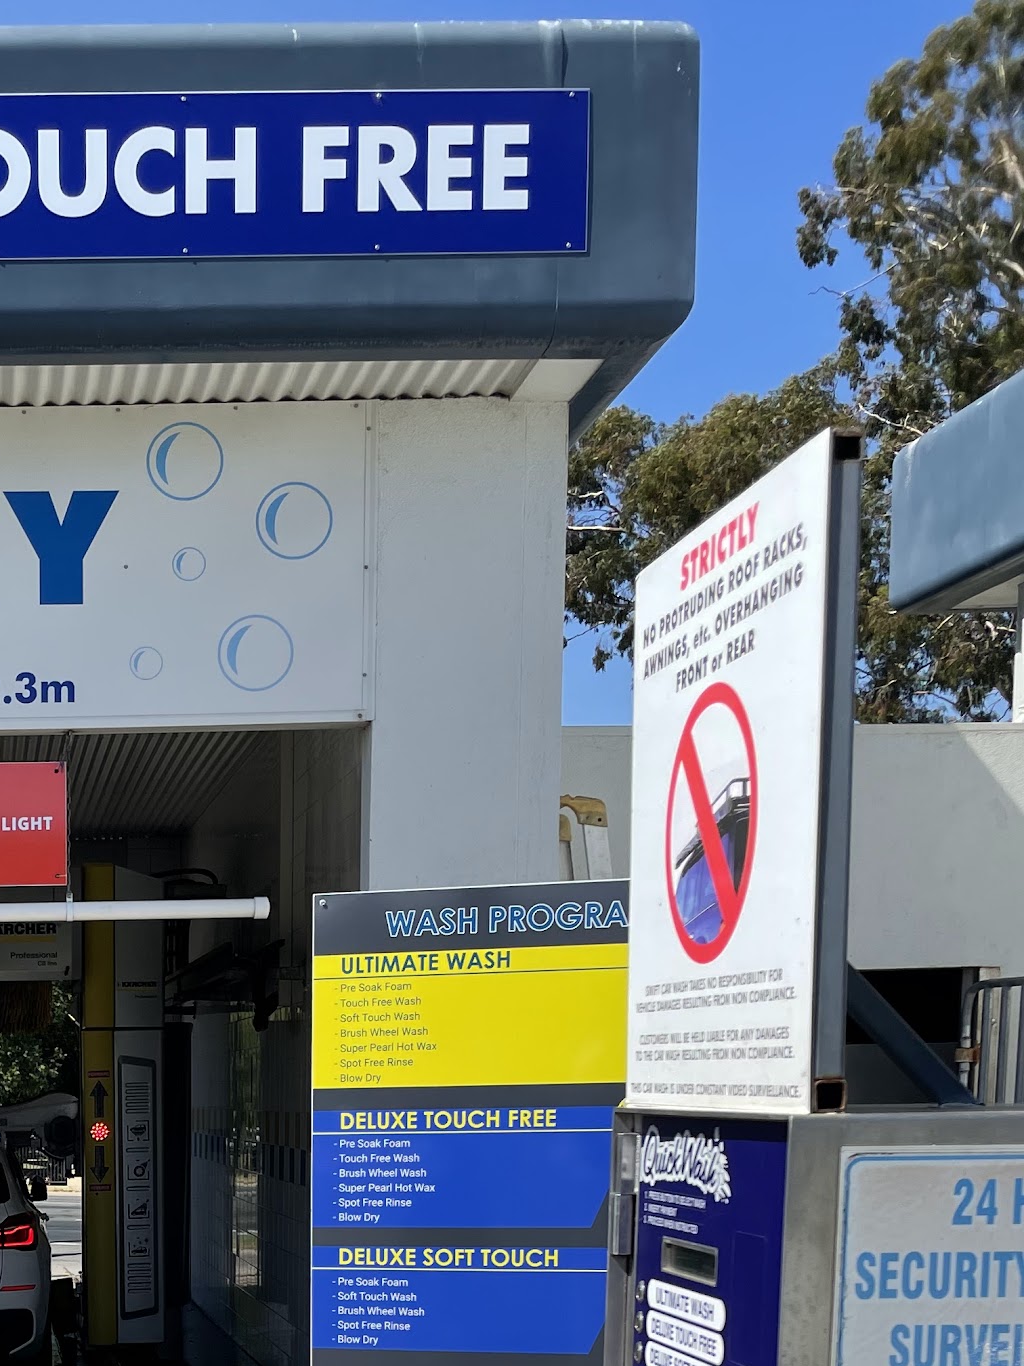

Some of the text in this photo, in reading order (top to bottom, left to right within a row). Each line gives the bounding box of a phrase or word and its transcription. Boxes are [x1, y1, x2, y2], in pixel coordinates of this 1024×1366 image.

[302, 123, 531, 213] FREE
[680, 501, 760, 591] STRICTLY
[643, 521, 808, 650] NO PROTRUDING ROOF RACKS,
[643, 561, 803, 680] AWNINGS, etc. OVERHANGING
[676, 629, 756, 693] FRONT or REAR
[0, 815, 54, 832] LIGHT
[385, 907, 478, 938] WASH
[10, 951, 58, 960] Professional
[341, 951, 511, 975] ULTIMATE WASH
[340, 981, 412, 993] Pre Soak Foam
[340, 996, 422, 1008] Touch Free Wash
[340, 1011, 421, 1023] Soft Touch Wash
[340, 1026, 429, 1038] Brush Wheel Wash
[756, 1026, 790, 1040] DAMAGES
[340, 1041, 437, 1055] Super Pearl Hot Wax
[340, 1057, 414, 1070] Spot Free Rinse
[340, 1073, 382, 1085] Blow Dry
[340, 1109, 557, 1130] DELUXE TOUCH FREE
[339, 1138, 411, 1148] Pre Soak Foam
[339, 1153, 420, 1163] Touch Free Wash
[339, 1168, 427, 1178] Brush Wheel Wash
[338, 1182, 436, 1195] Super Pearl Hot Wax
[338, 1197, 412, 1209] Spot Free Rinse
[952, 1178, 999, 1225] 24
[338, 1212, 380, 1224] Blow Dry
[339, 1247, 559, 1267] DELUXE SOFT TOUCH
[337, 1277, 409, 1287] Pre Soak Foam
[337, 1291, 417, 1302] Soft Touch Wash
[656, 1286, 715, 1322] ULTIMATE WASH
[337, 1306, 425, 1316] Brush Wheel Wash
[337, 1320, 411, 1332] Spot Free Rinse
[337, 1334, 378, 1346] Blow Dry
[651, 1317, 717, 1357] DELUXE TOUCH FREE
